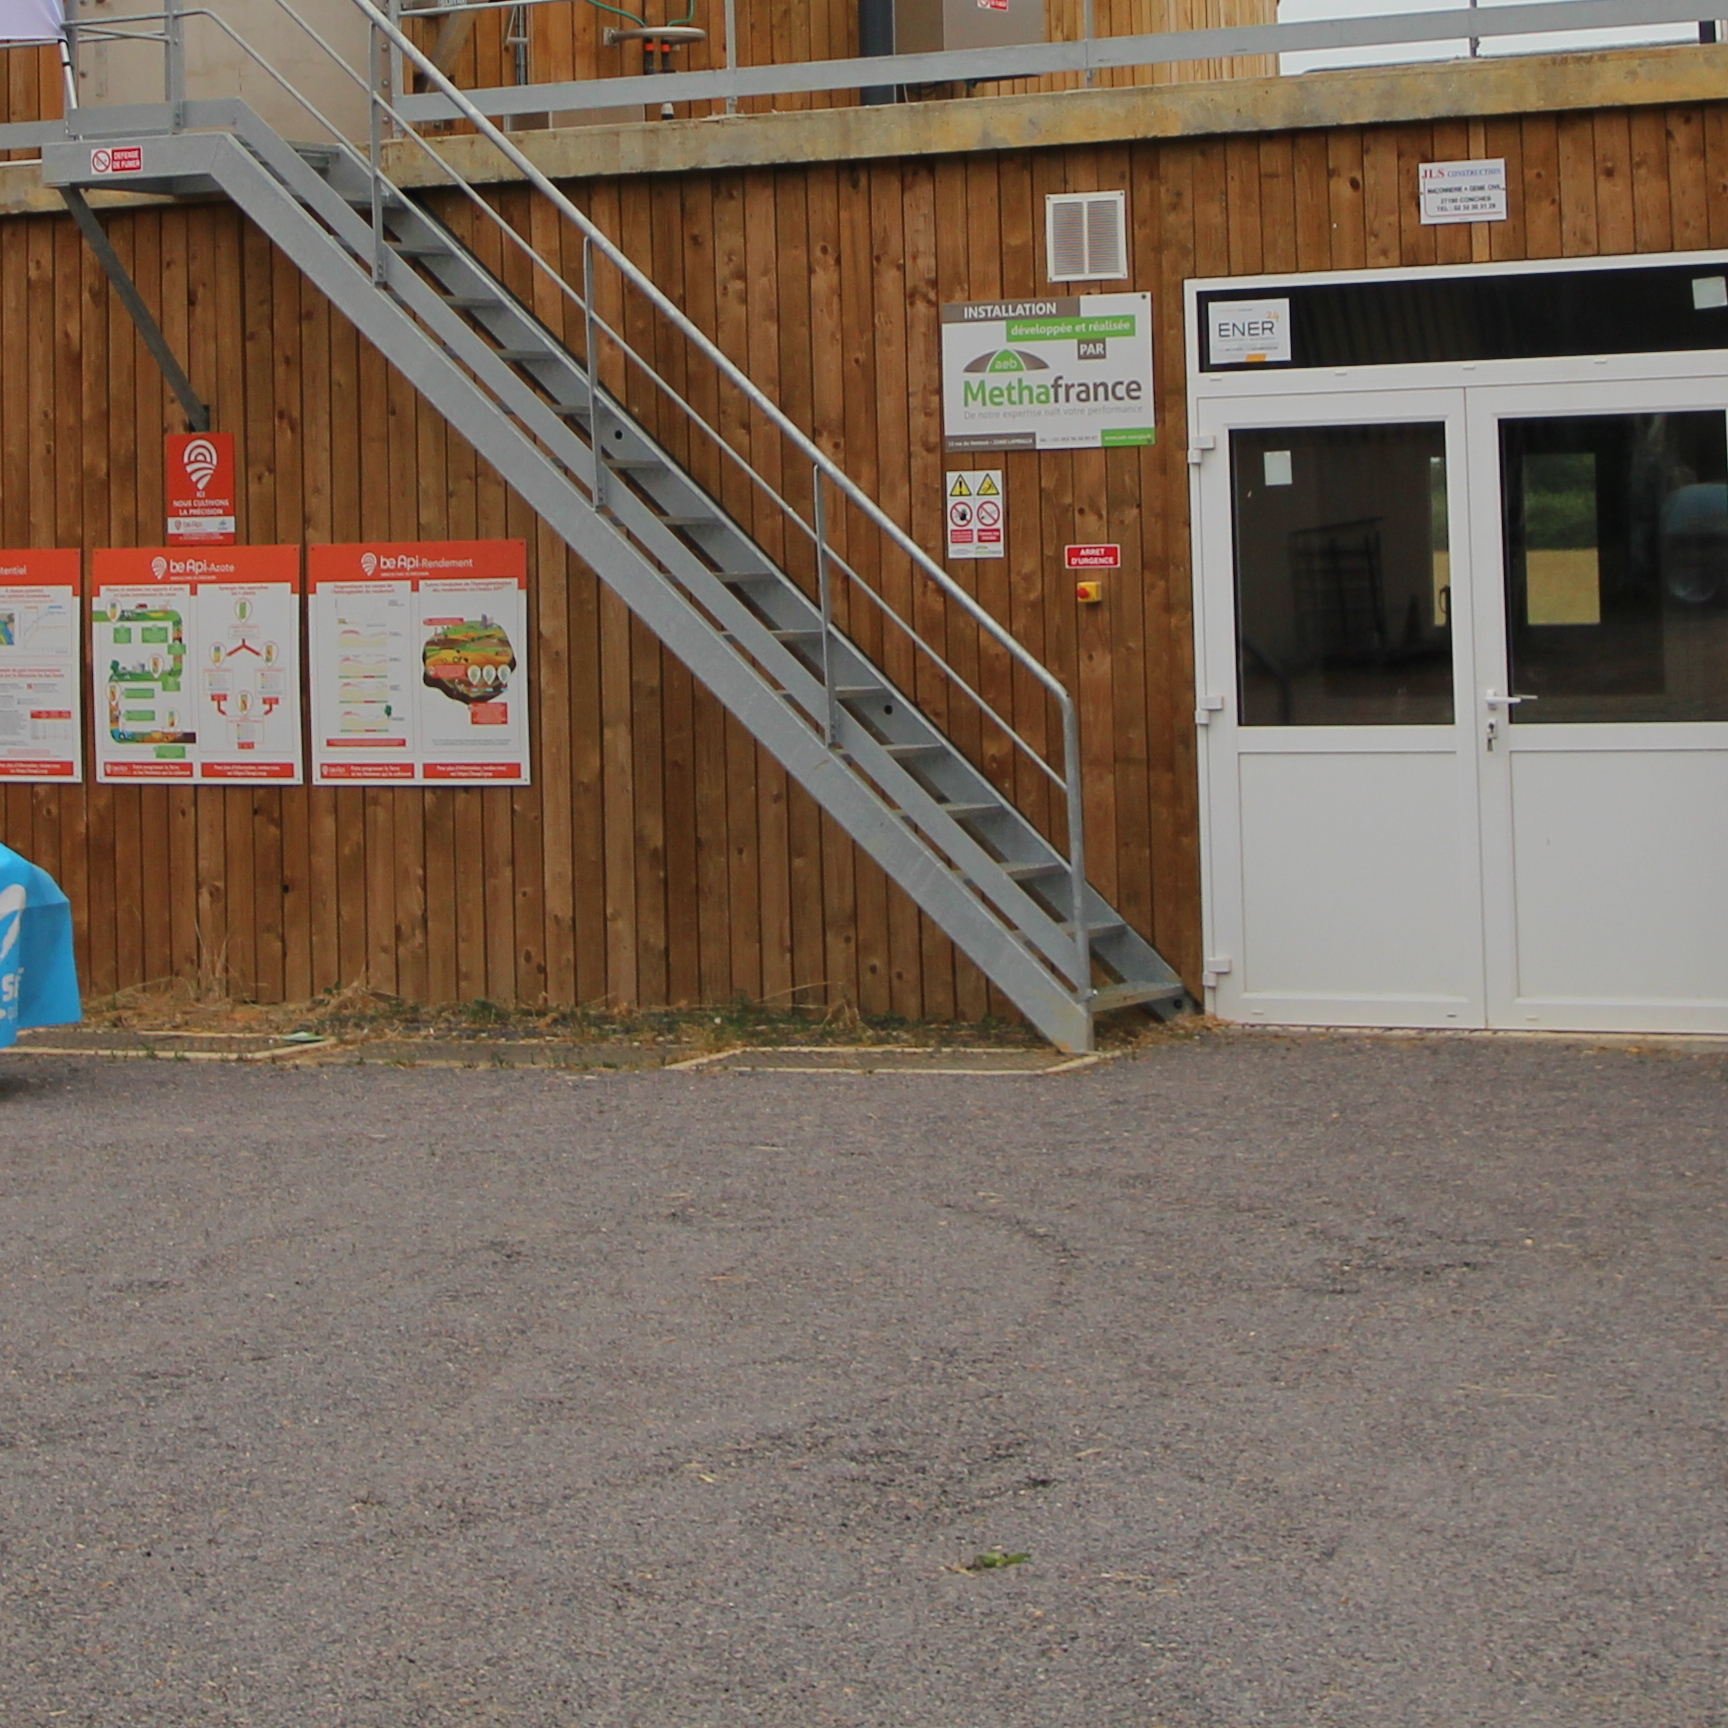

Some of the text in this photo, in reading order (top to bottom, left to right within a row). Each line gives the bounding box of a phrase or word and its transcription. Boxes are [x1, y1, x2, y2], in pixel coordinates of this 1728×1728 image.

[1422, 168, 1445, 180] JLS
[964, 302, 1057, 319] INSTALLATION
[1011, 319, 1131, 336] développée et réalisée
[1218, 320, 1275, 338] ENER
[1079, 343, 1105, 355] PAR
[995, 355, 1017, 369] aeb
[963, 375, 1142, 408] Methafrance
[977, 410, 1000, 420] notre
[1002, 407, 1042, 420] expertise
[1063, 406, 1085, 416] votre
[1087, 404, 1143, 417] performance
[173, 499, 229, 507] NOUS CULTIVONS
[1079, 548, 1106, 556] ARRET
[170, 559, 185, 573] be
[380, 555, 396, 569] be
[1070, 556, 1115, 565] D'URGENCE
